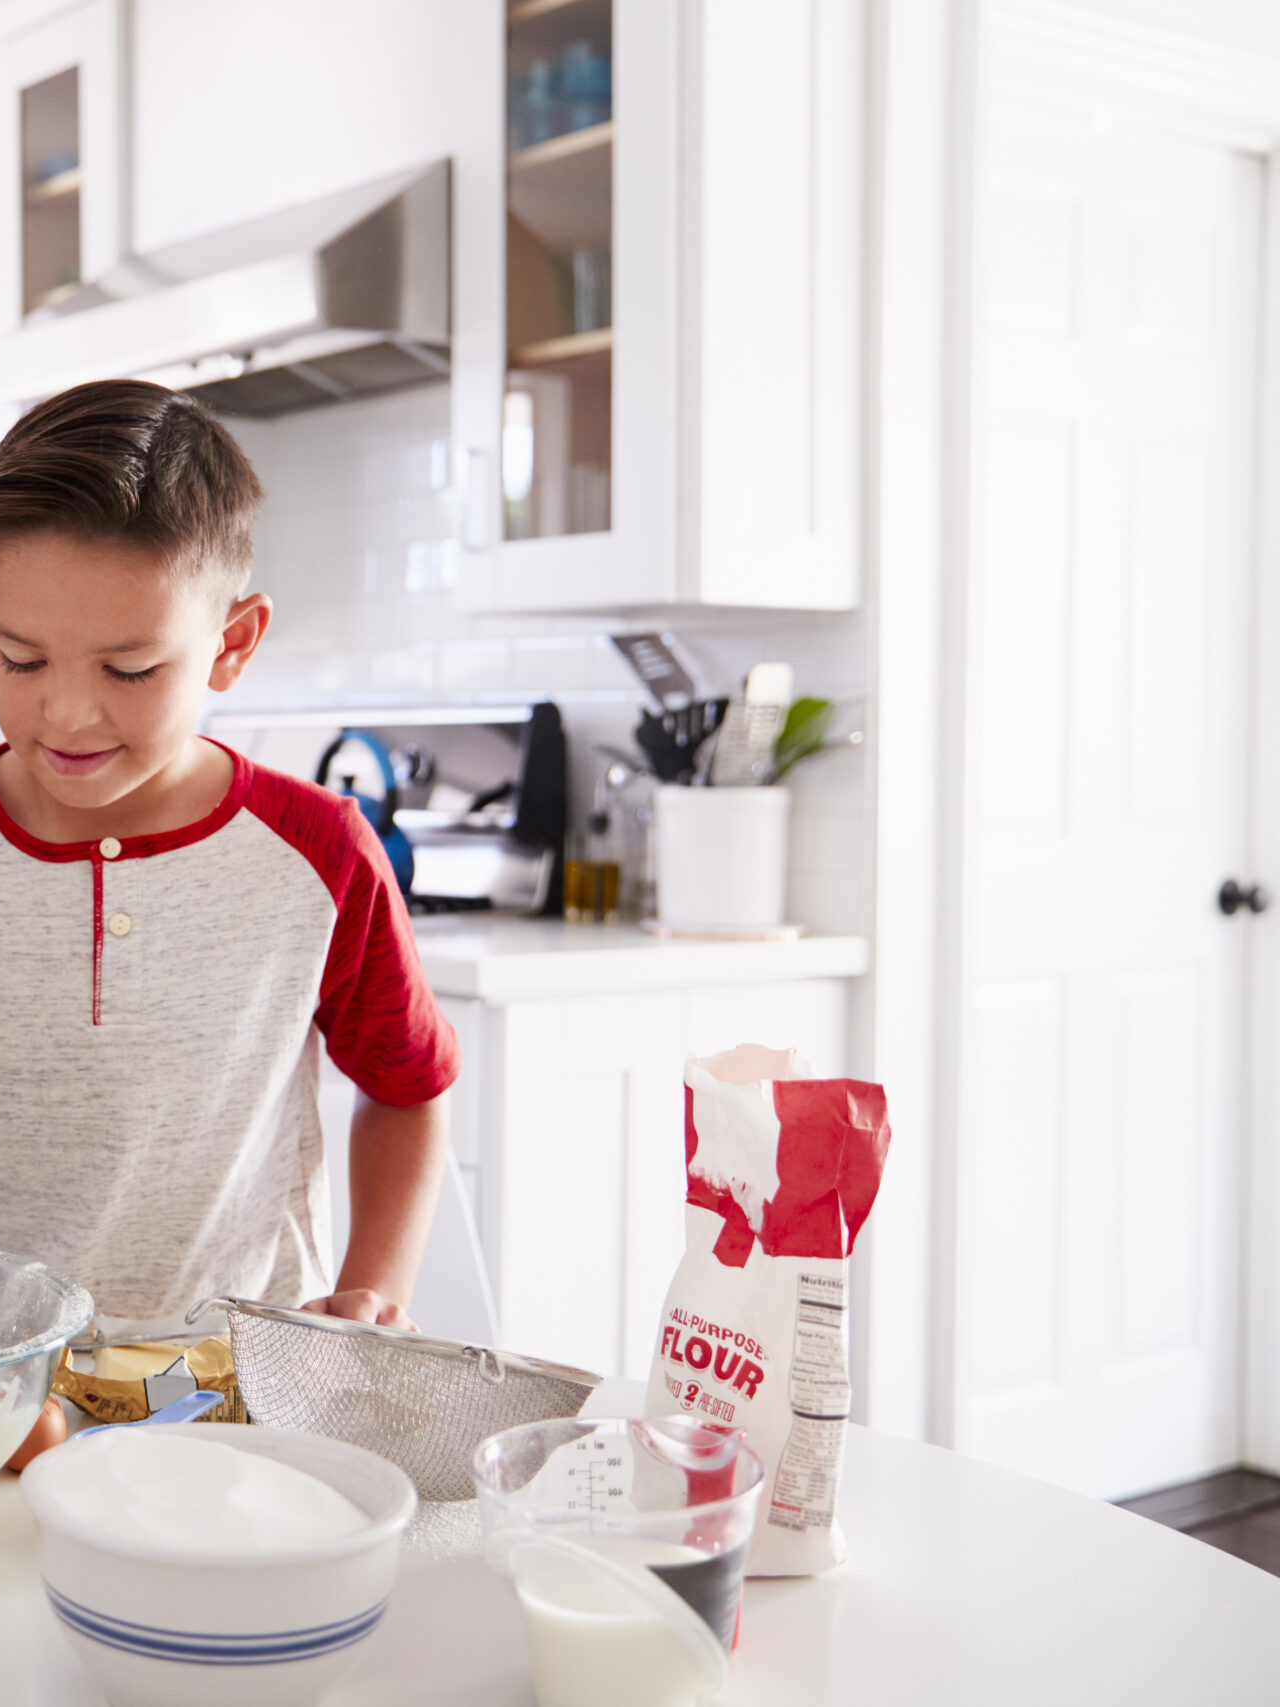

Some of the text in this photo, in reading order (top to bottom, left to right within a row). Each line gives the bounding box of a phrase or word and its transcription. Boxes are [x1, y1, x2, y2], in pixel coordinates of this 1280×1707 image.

[671, 1307, 764, 1360] ALL-PURPOSE
[661, 1325, 765, 1402] FLOUR
[684, 1384, 699, 1403] 2
[697, 1392, 736, 1422] PRE-SIFTED
